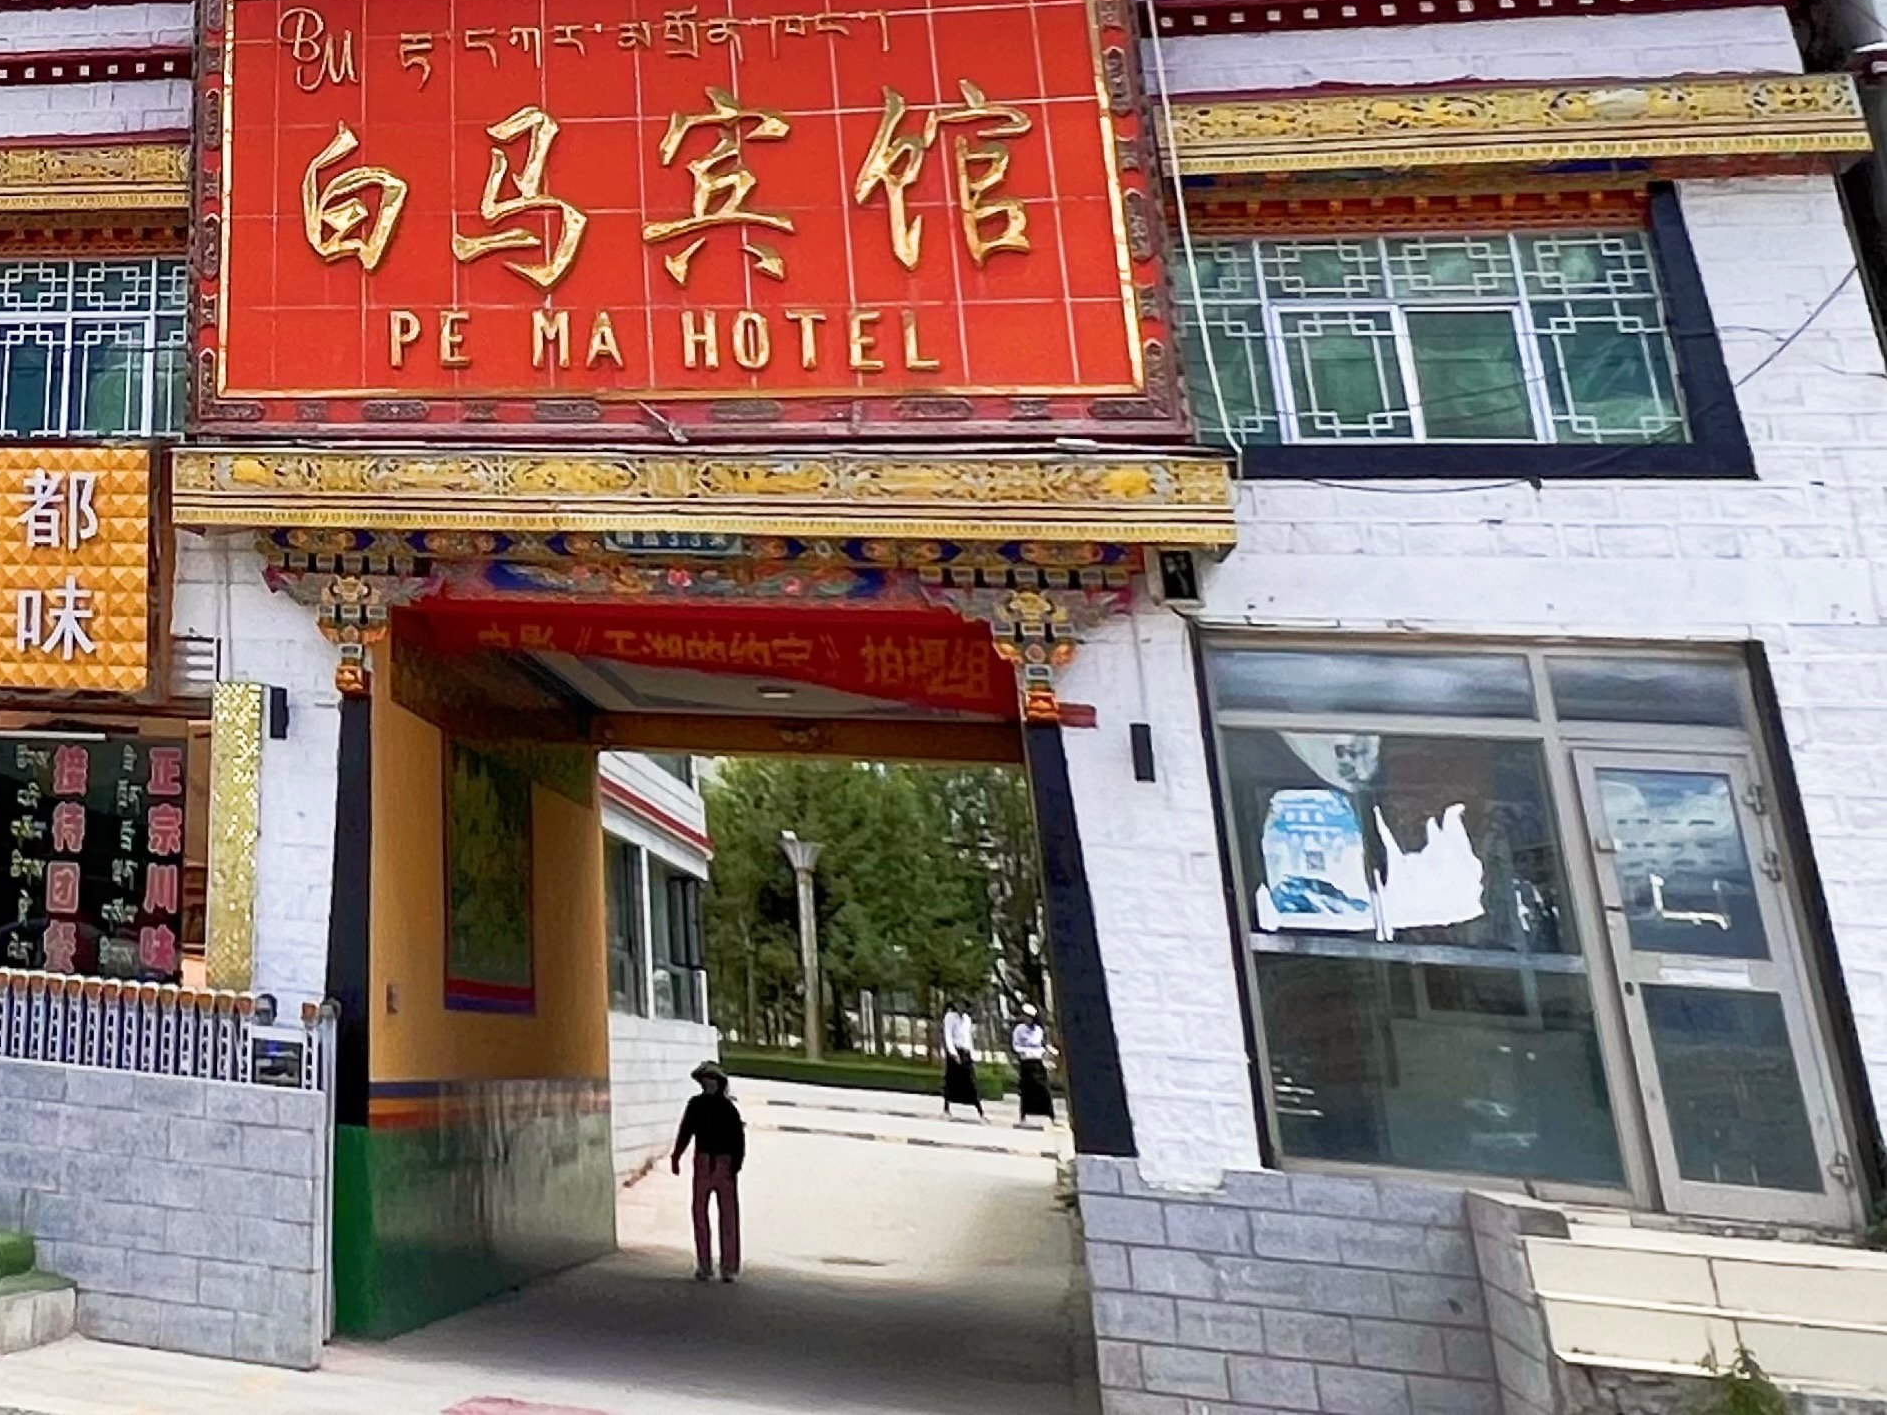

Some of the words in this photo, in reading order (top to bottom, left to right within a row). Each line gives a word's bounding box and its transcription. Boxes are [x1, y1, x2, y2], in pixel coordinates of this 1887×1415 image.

[300, 79, 1034, 291] 白马宾馆
[388, 309, 473, 370] PE
[531, 310, 625, 371] MA
[681, 306, 944, 373] HOTEL
[15, 574, 99, 662] 味
[43, 743, 90, 974] 接待团餐
[139, 746, 183, 976] 正宗川味
